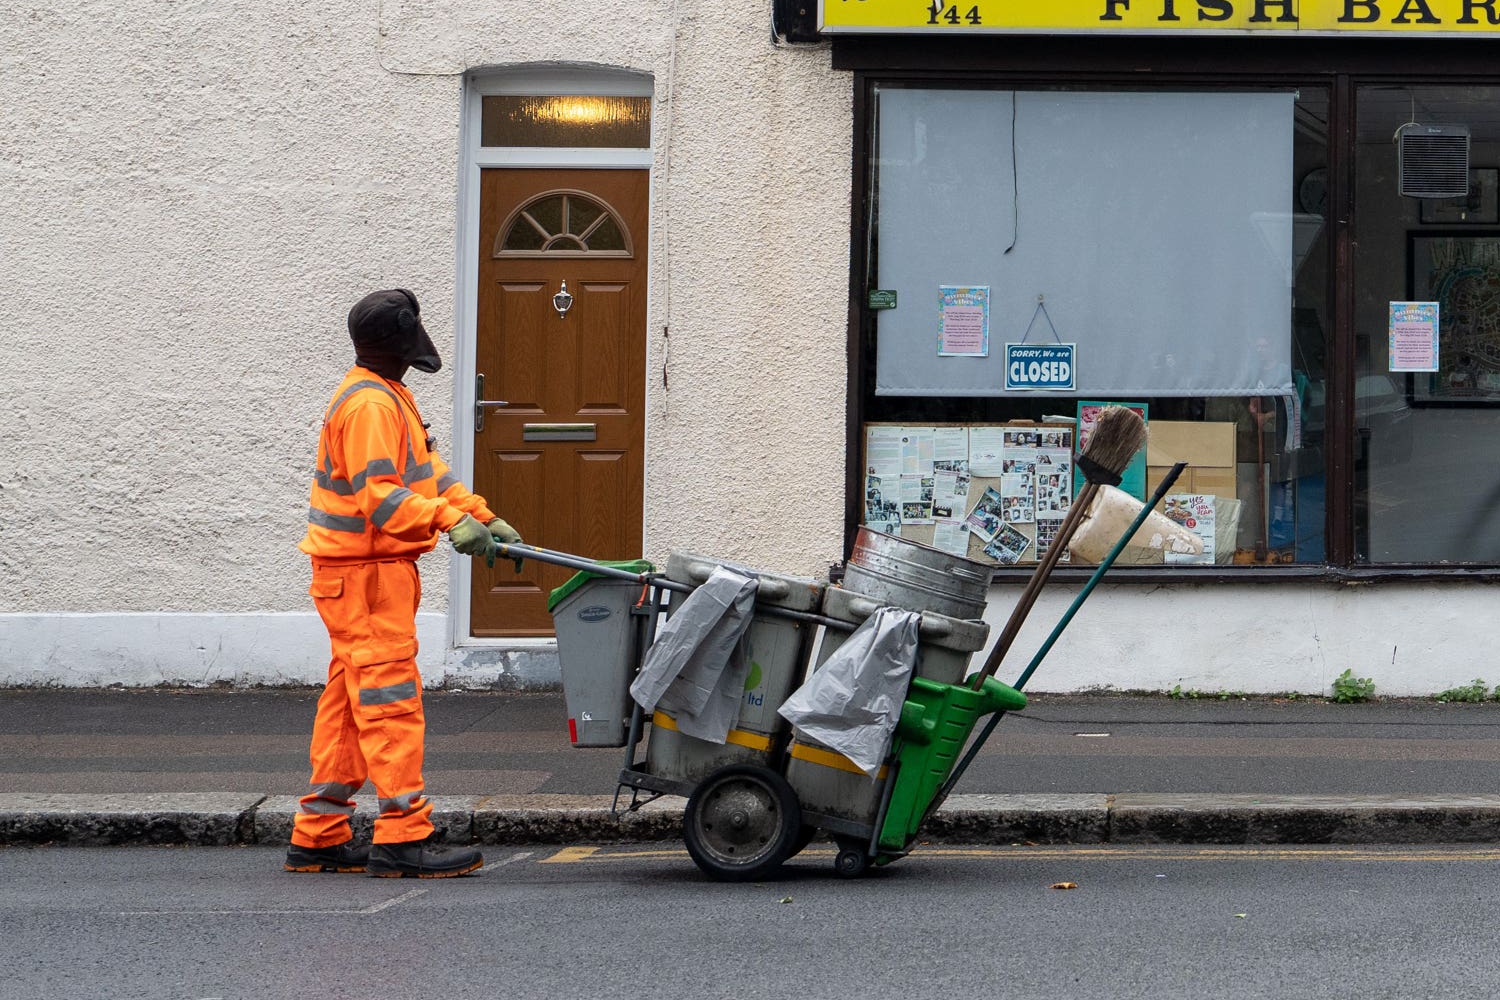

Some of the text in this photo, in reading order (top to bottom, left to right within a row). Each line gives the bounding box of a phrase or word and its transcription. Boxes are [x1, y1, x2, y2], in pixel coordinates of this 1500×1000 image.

[926, 5, 982, 25] 144
[1042, 350, 1055, 358] We
[1010, 361, 1071, 382] CLOSED
[747, 692, 764, 706] ltd
